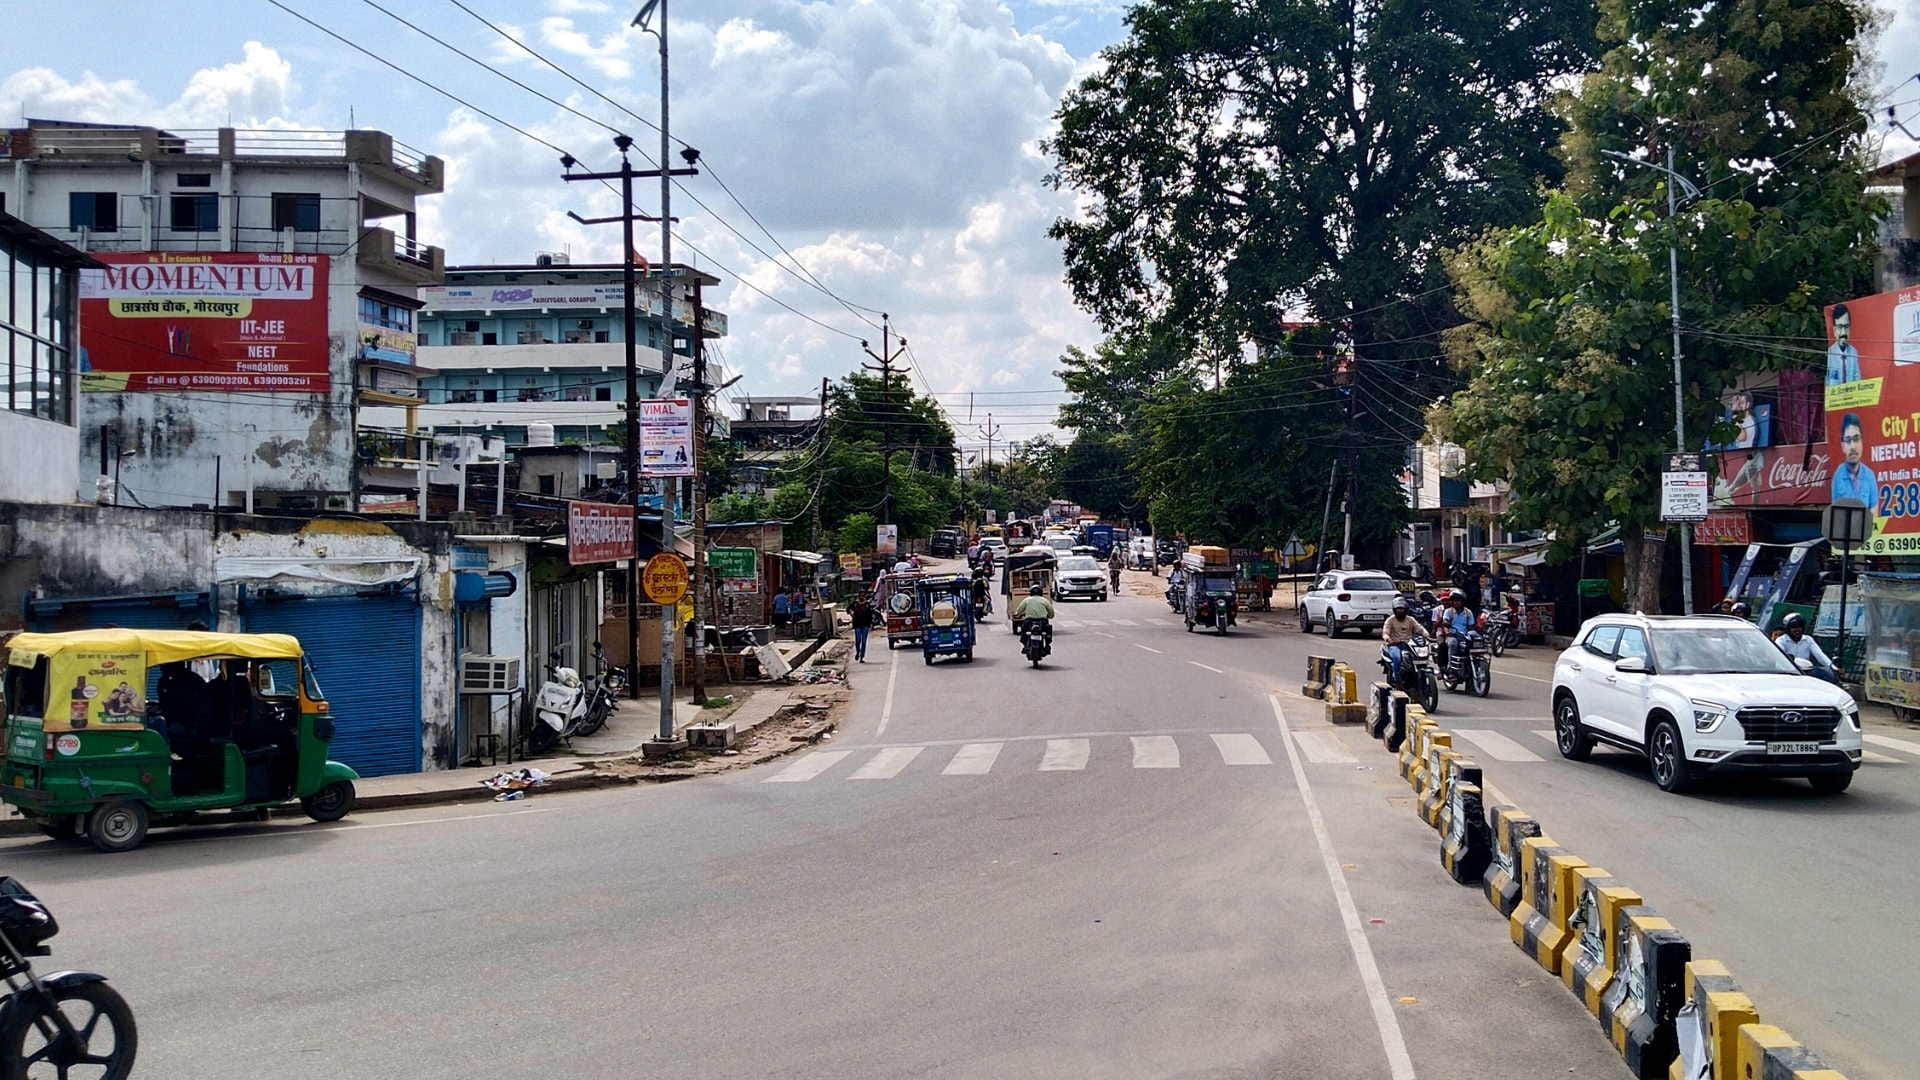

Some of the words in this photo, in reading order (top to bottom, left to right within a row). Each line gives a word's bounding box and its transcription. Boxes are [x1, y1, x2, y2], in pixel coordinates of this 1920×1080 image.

[283, 254, 293, 263] 20
[101, 265, 304, 291] MOMENTUM
[192, 299, 239, 316] गोरखपुर
[240, 319, 285, 334] IIT-JEE
[248, 346, 277, 358] NEET
[236, 362, 289, 372] Foundations
[147, 376, 165, 385] Call
[642, 404, 676, 416] VIMAL
[1882, 415, 1908, 440] City
[1871, 441, 1916, 462] NEET-UG
[1889, 469, 1910, 480] India
